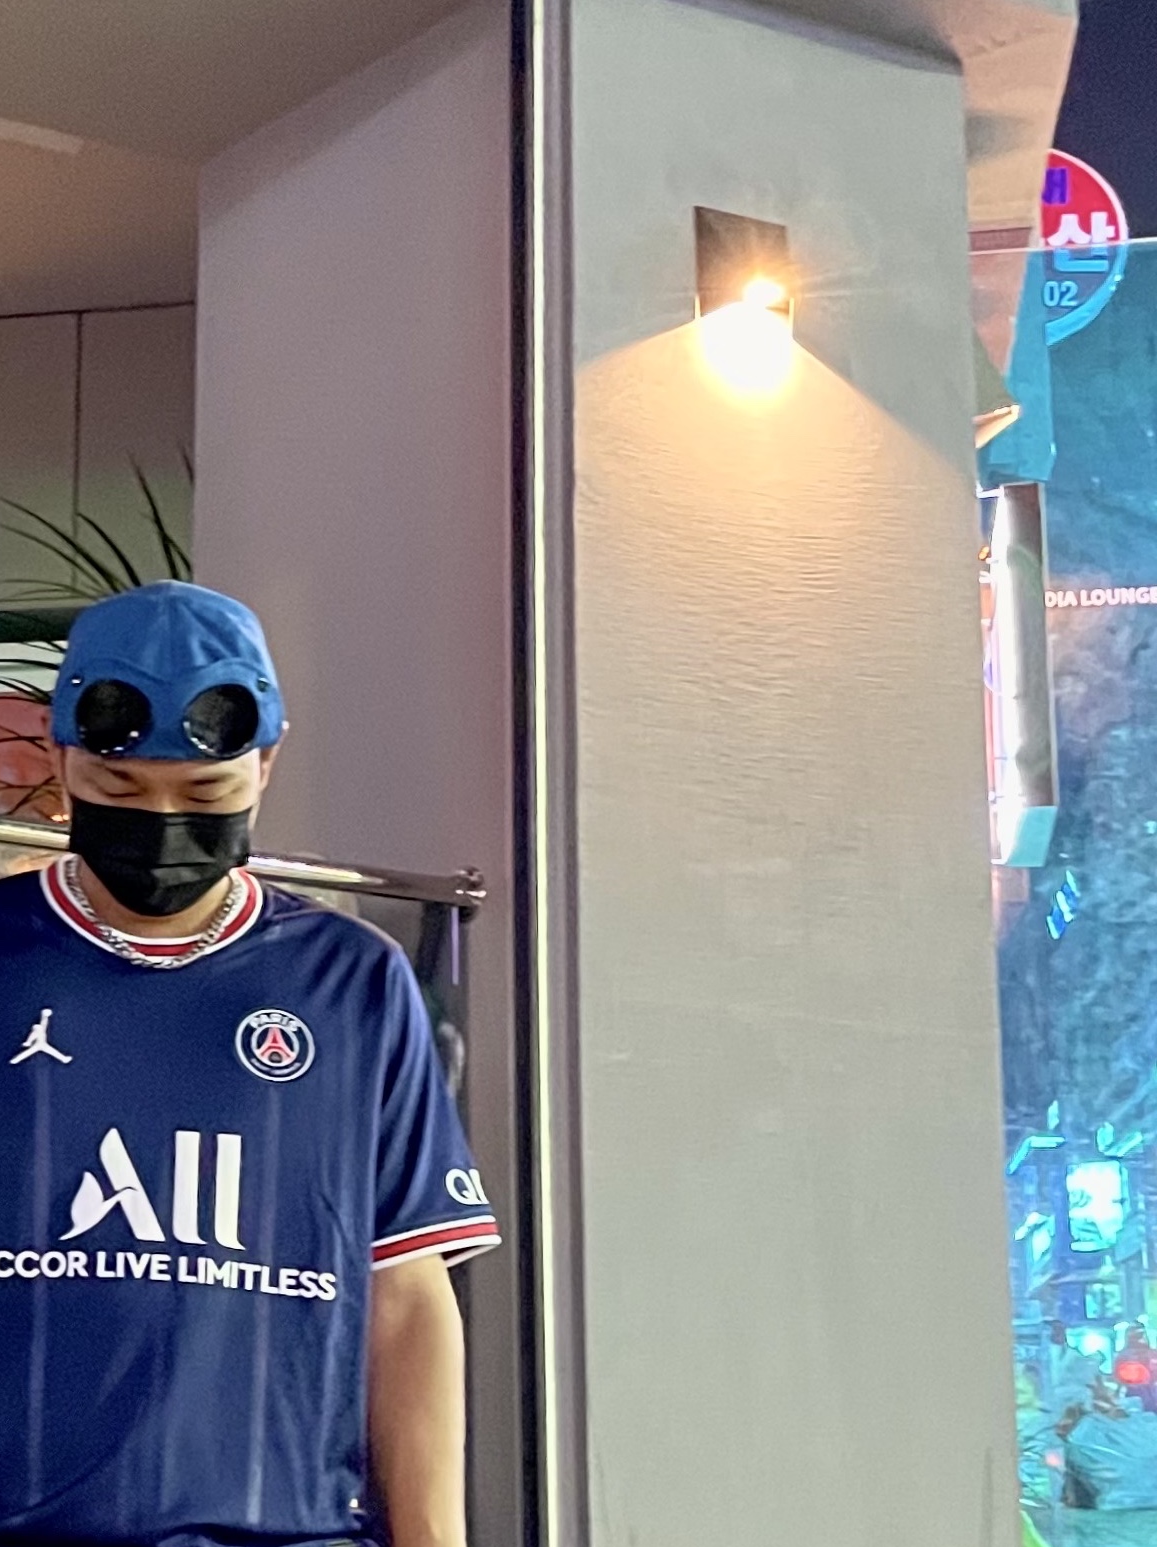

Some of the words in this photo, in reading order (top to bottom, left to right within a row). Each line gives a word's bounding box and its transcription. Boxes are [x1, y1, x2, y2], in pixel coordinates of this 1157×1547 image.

[1042, 211, 1115, 272] 산
[1080, 586, 1157, 607] LOUNGE
[96, 1251, 171, 1282] LIVE
[178, 1256, 337, 1301] LIMITLESS
